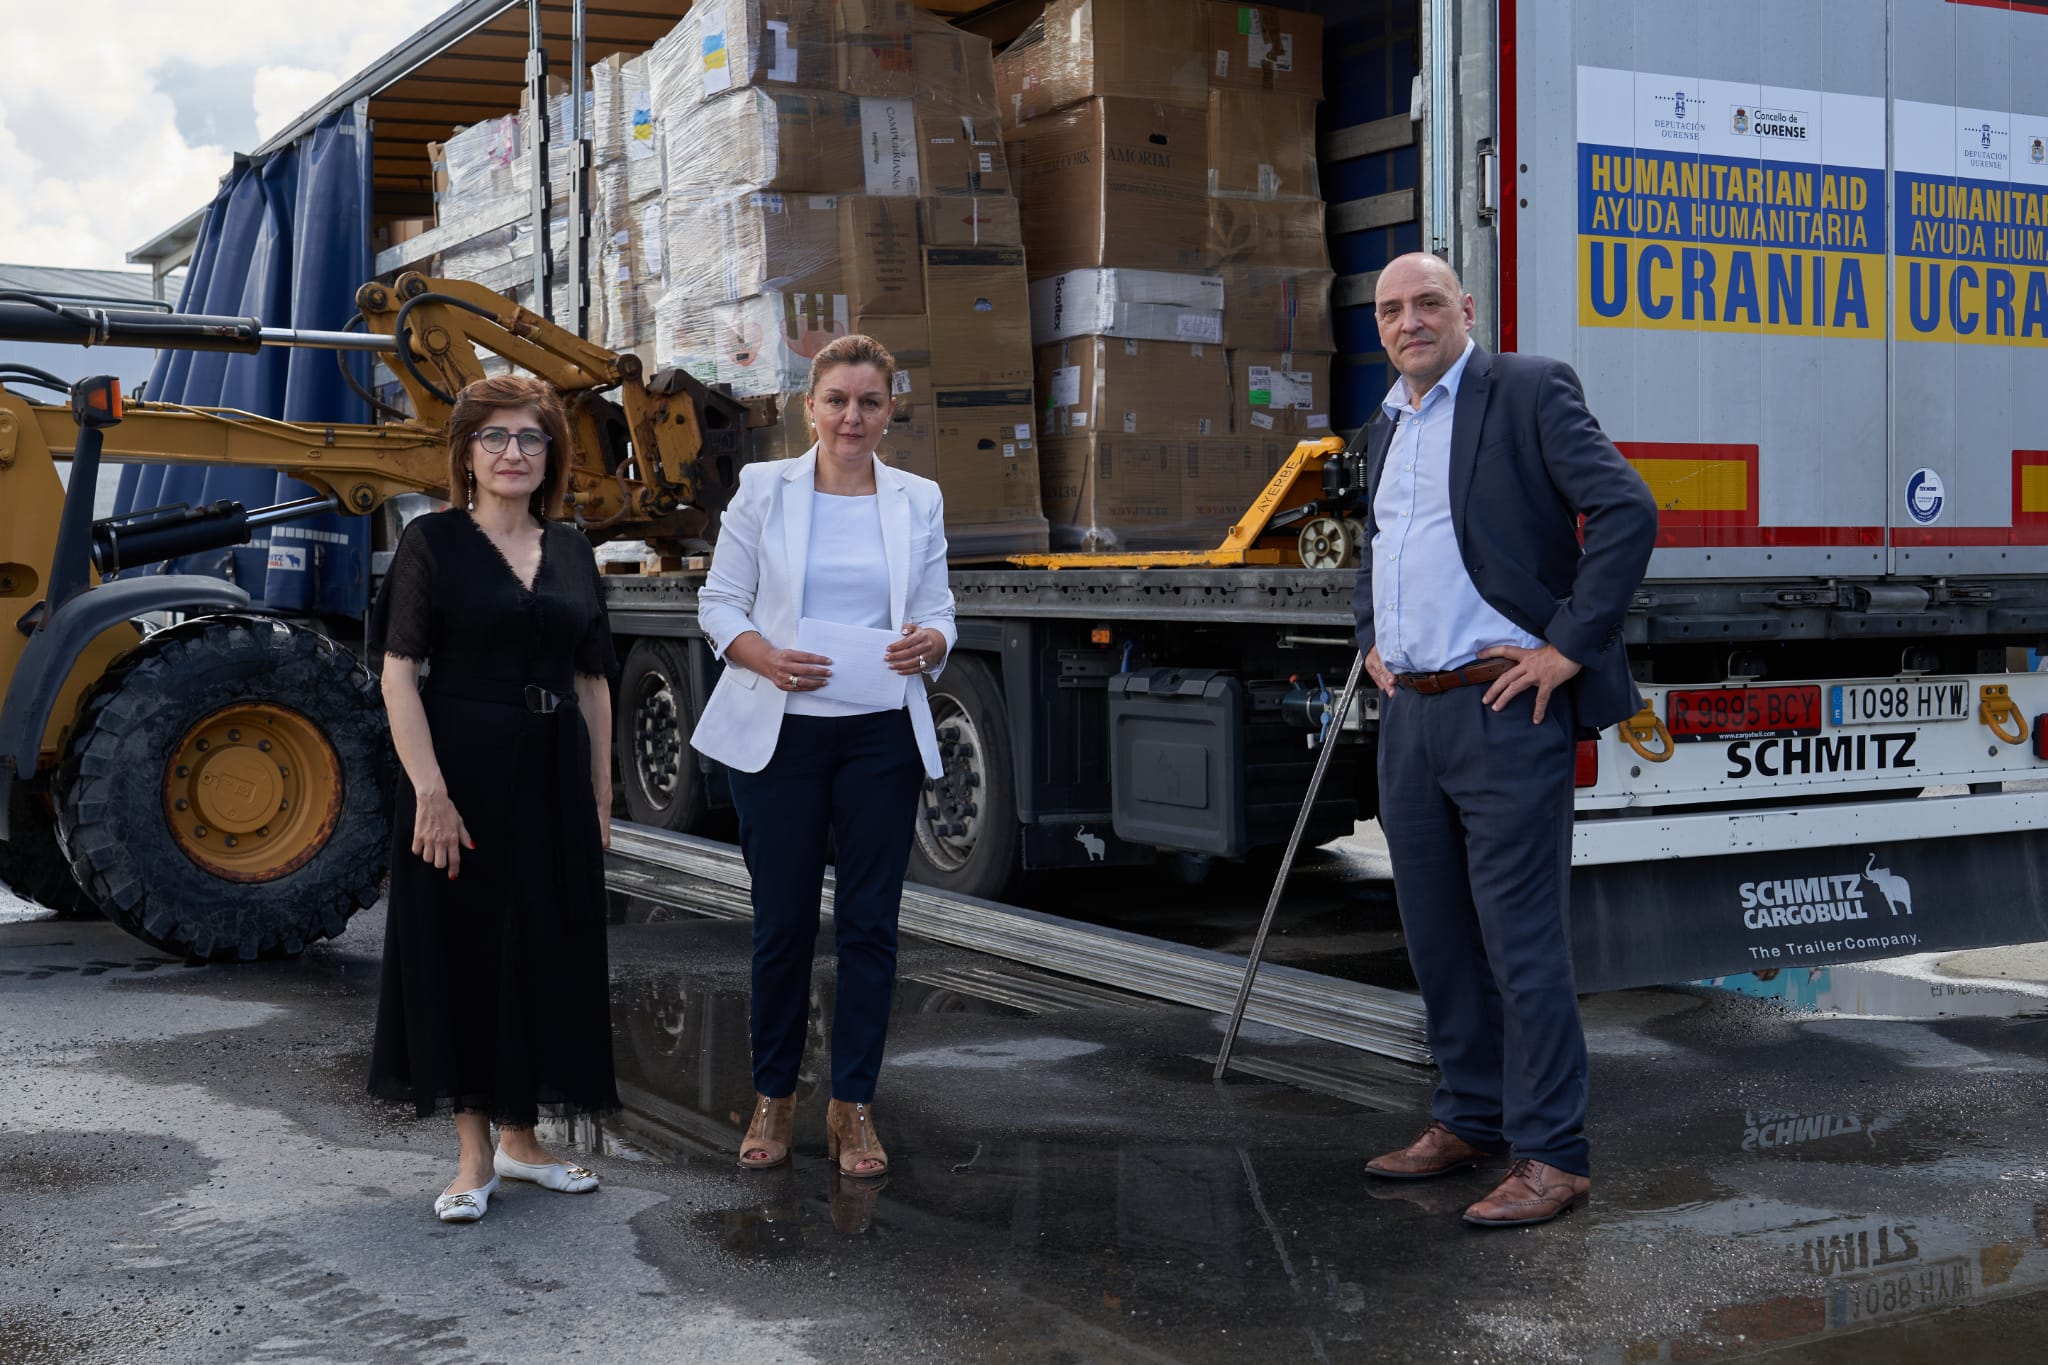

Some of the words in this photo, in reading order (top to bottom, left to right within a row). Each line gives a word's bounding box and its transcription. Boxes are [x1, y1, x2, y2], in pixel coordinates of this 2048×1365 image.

[1654, 118, 1706, 132] DEPUTACIÓN
[1754, 111, 1787, 123] Concello
[1789, 113, 1798, 123] de
[1754, 123, 1806, 139] OURENSE
[1661, 130, 1700, 140] OURENSE
[1970, 159, 2002, 169] OURENSE
[1591, 154, 1815, 208] HUMANITARIAN
[1822, 174, 1868, 212] AID
[1591, 196, 1682, 236] AYUDA
[1690, 202, 1868, 248] HUMANITARIA
[1911, 220, 1986, 257] AYUDA
[1995, 227, 2048, 262] HUM
[1589, 241, 1870, 329] UCRANIA
[1909, 262, 2048, 338] UCRA
[1674, 698, 1690, 729] R
[1697, 694, 1760, 727] 9895
[1770, 691, 1816, 724] BCY
[1849, 689, 1908, 719] 1098
[1917, 685, 1964, 716] HYW
[1726, 732, 1917, 779] SCHMITZ
[1738, 873, 1864, 909] SCHMITZ
[1743, 900, 1868, 930] CARGOBULL
[1749, 946, 1781, 960] The
